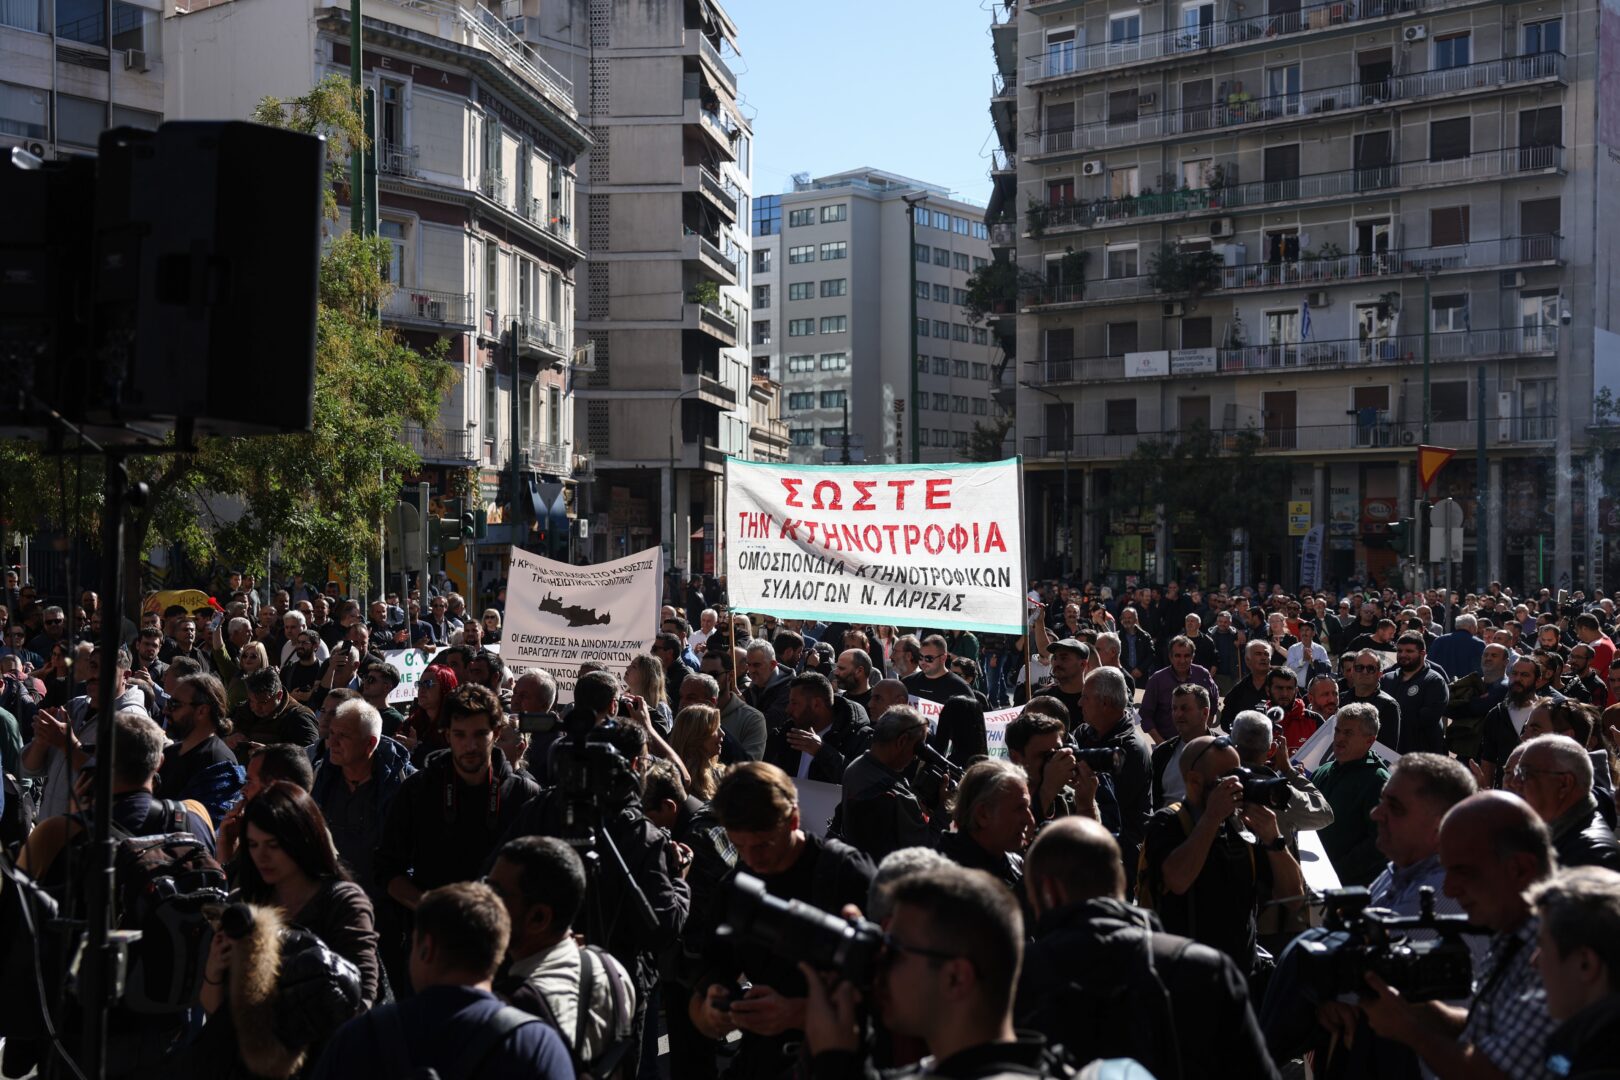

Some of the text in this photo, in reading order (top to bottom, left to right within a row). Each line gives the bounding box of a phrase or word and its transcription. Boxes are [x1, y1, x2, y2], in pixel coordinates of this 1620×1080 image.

[381, 56, 449, 84] ΕΓΑ
[780, 478, 952, 511] ΣΩΣΤΕ
[738, 512, 1007, 555] ΤΗΝ ΚΤΗΝΟΤΡΟΦΙΑ
[738, 551, 1011, 588] ΟΜΟΣΠΟΝΔΙΑ ΚΤΗΝΟΤΡΟΦΙΚΩΝ
[761, 578, 966, 612] ΣΥΛΛΟΓΩΝ Ν. ΛΑΡΙΣΑΣ
[512, 633, 643, 649] ΟΙ ΕΝΙΣΧΥΣΕΙΣ ΝΑ ΔΙΝΟΝΤΑΙ ΣΤΗΝ
[518, 646, 632, 662] ΠΑΡΑΓΩΓΗ ΤΩΝ ΠΡΟΪΟΝΤΩΝ
